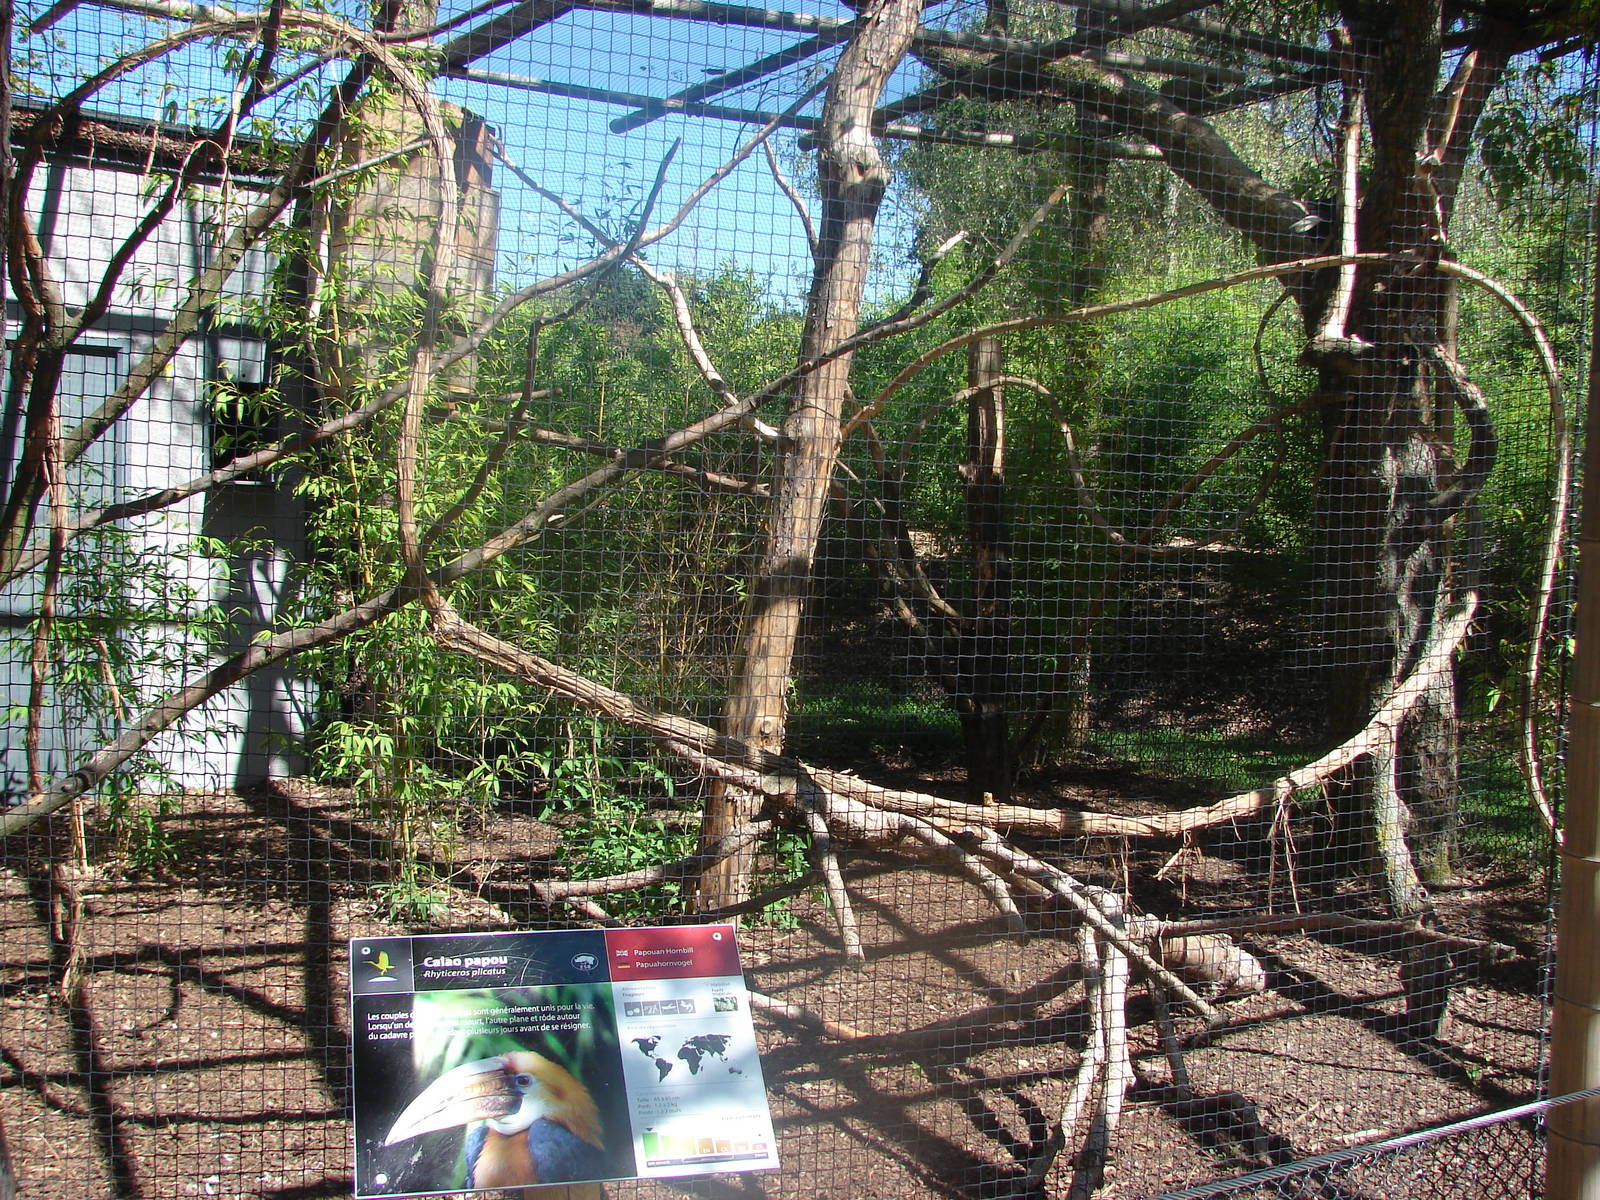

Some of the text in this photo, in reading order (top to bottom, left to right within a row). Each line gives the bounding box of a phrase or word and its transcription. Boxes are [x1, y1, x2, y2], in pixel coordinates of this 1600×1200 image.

[634, 949, 665, 957] Papouan
[423, 955, 508, 968] Calao papou
[635, 960, 693, 968] Papuahornvogel
[424, 968, 506, 979] Rhyticeros plicatus
[380, 1011, 408, 1021] couples
[489, 1006, 540, 1017] généralement
[556, 1005, 574, 1013] pour
[509, 1015, 530, 1024] plane
[368, 1032, 378, 1040] du
[379, 1031, 408, 1040] cadavre
[500, 1026, 519, 1035] jours
[519, 1024, 540, 1032] avant
[540, 1023, 550, 1031] de
